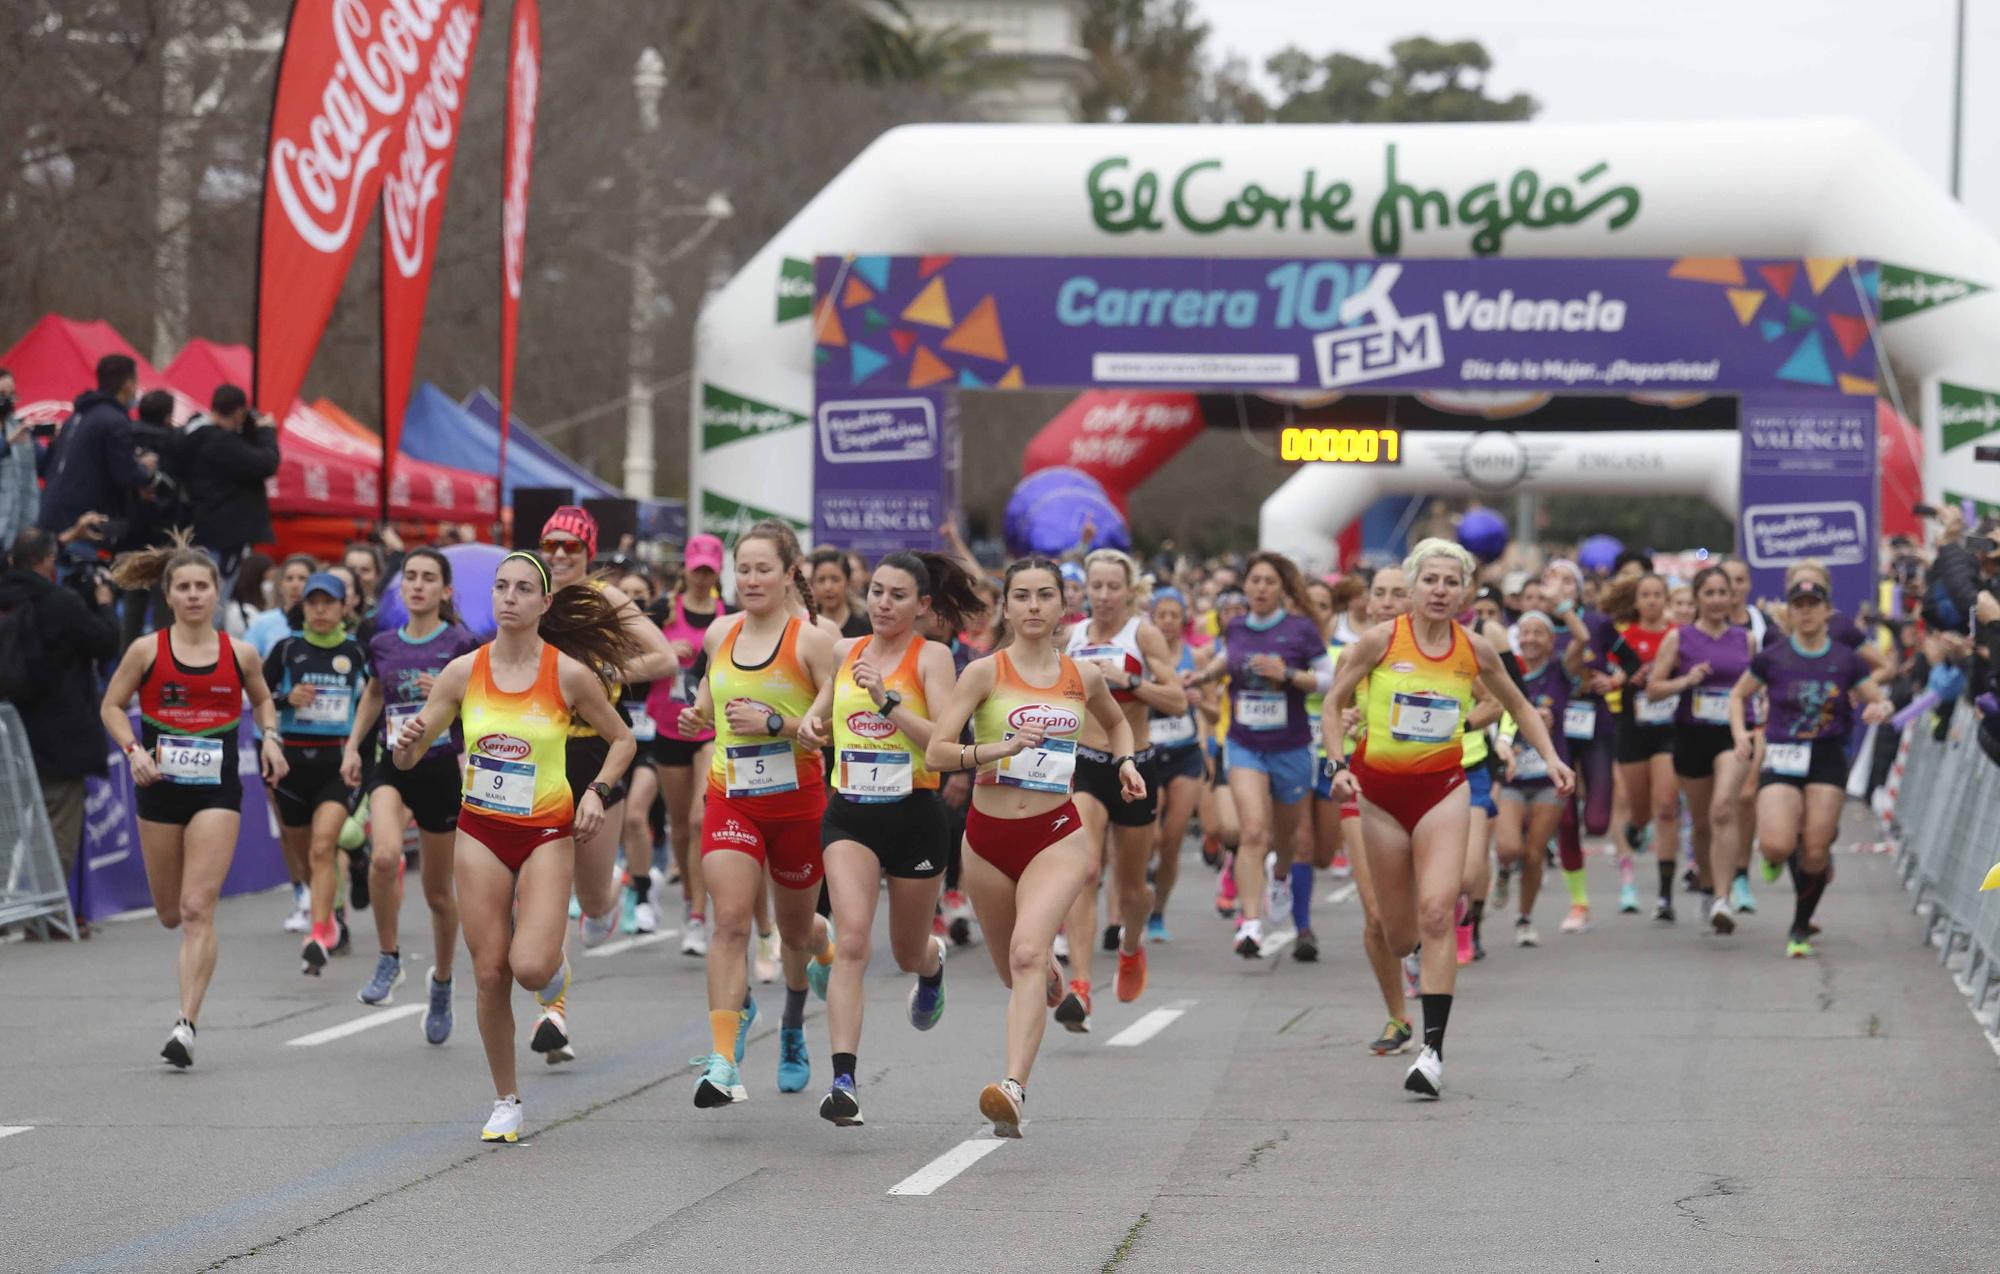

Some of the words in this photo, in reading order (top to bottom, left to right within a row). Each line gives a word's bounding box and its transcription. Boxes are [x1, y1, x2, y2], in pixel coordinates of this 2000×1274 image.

[1086, 156, 1163, 234] El
[1172, 160, 1357, 234] Corte
[1369, 143, 1641, 257] Inglés
[1056, 276, 1260, 328] Carrera
[1443, 290, 1627, 333] Valencia
[1329, 323, 1429, 379] FEM
[1281, 427, 1399, 463] 000007
[851, 718, 893, 732] Serrano
[1015, 711, 1078, 728] Serrano
[1420, 710, 1432, 724] 3
[481, 740, 527, 755] Serrano
[169, 751, 212, 767] 1649
[754, 759, 766, 775] 5
[1036, 751, 1048, 768] 7
[870, 766, 879, 782] 1
[1028, 770, 1048, 779] LIDIA
[492, 775, 504, 791] 9
[712, 830, 758, 844] SERRANO
